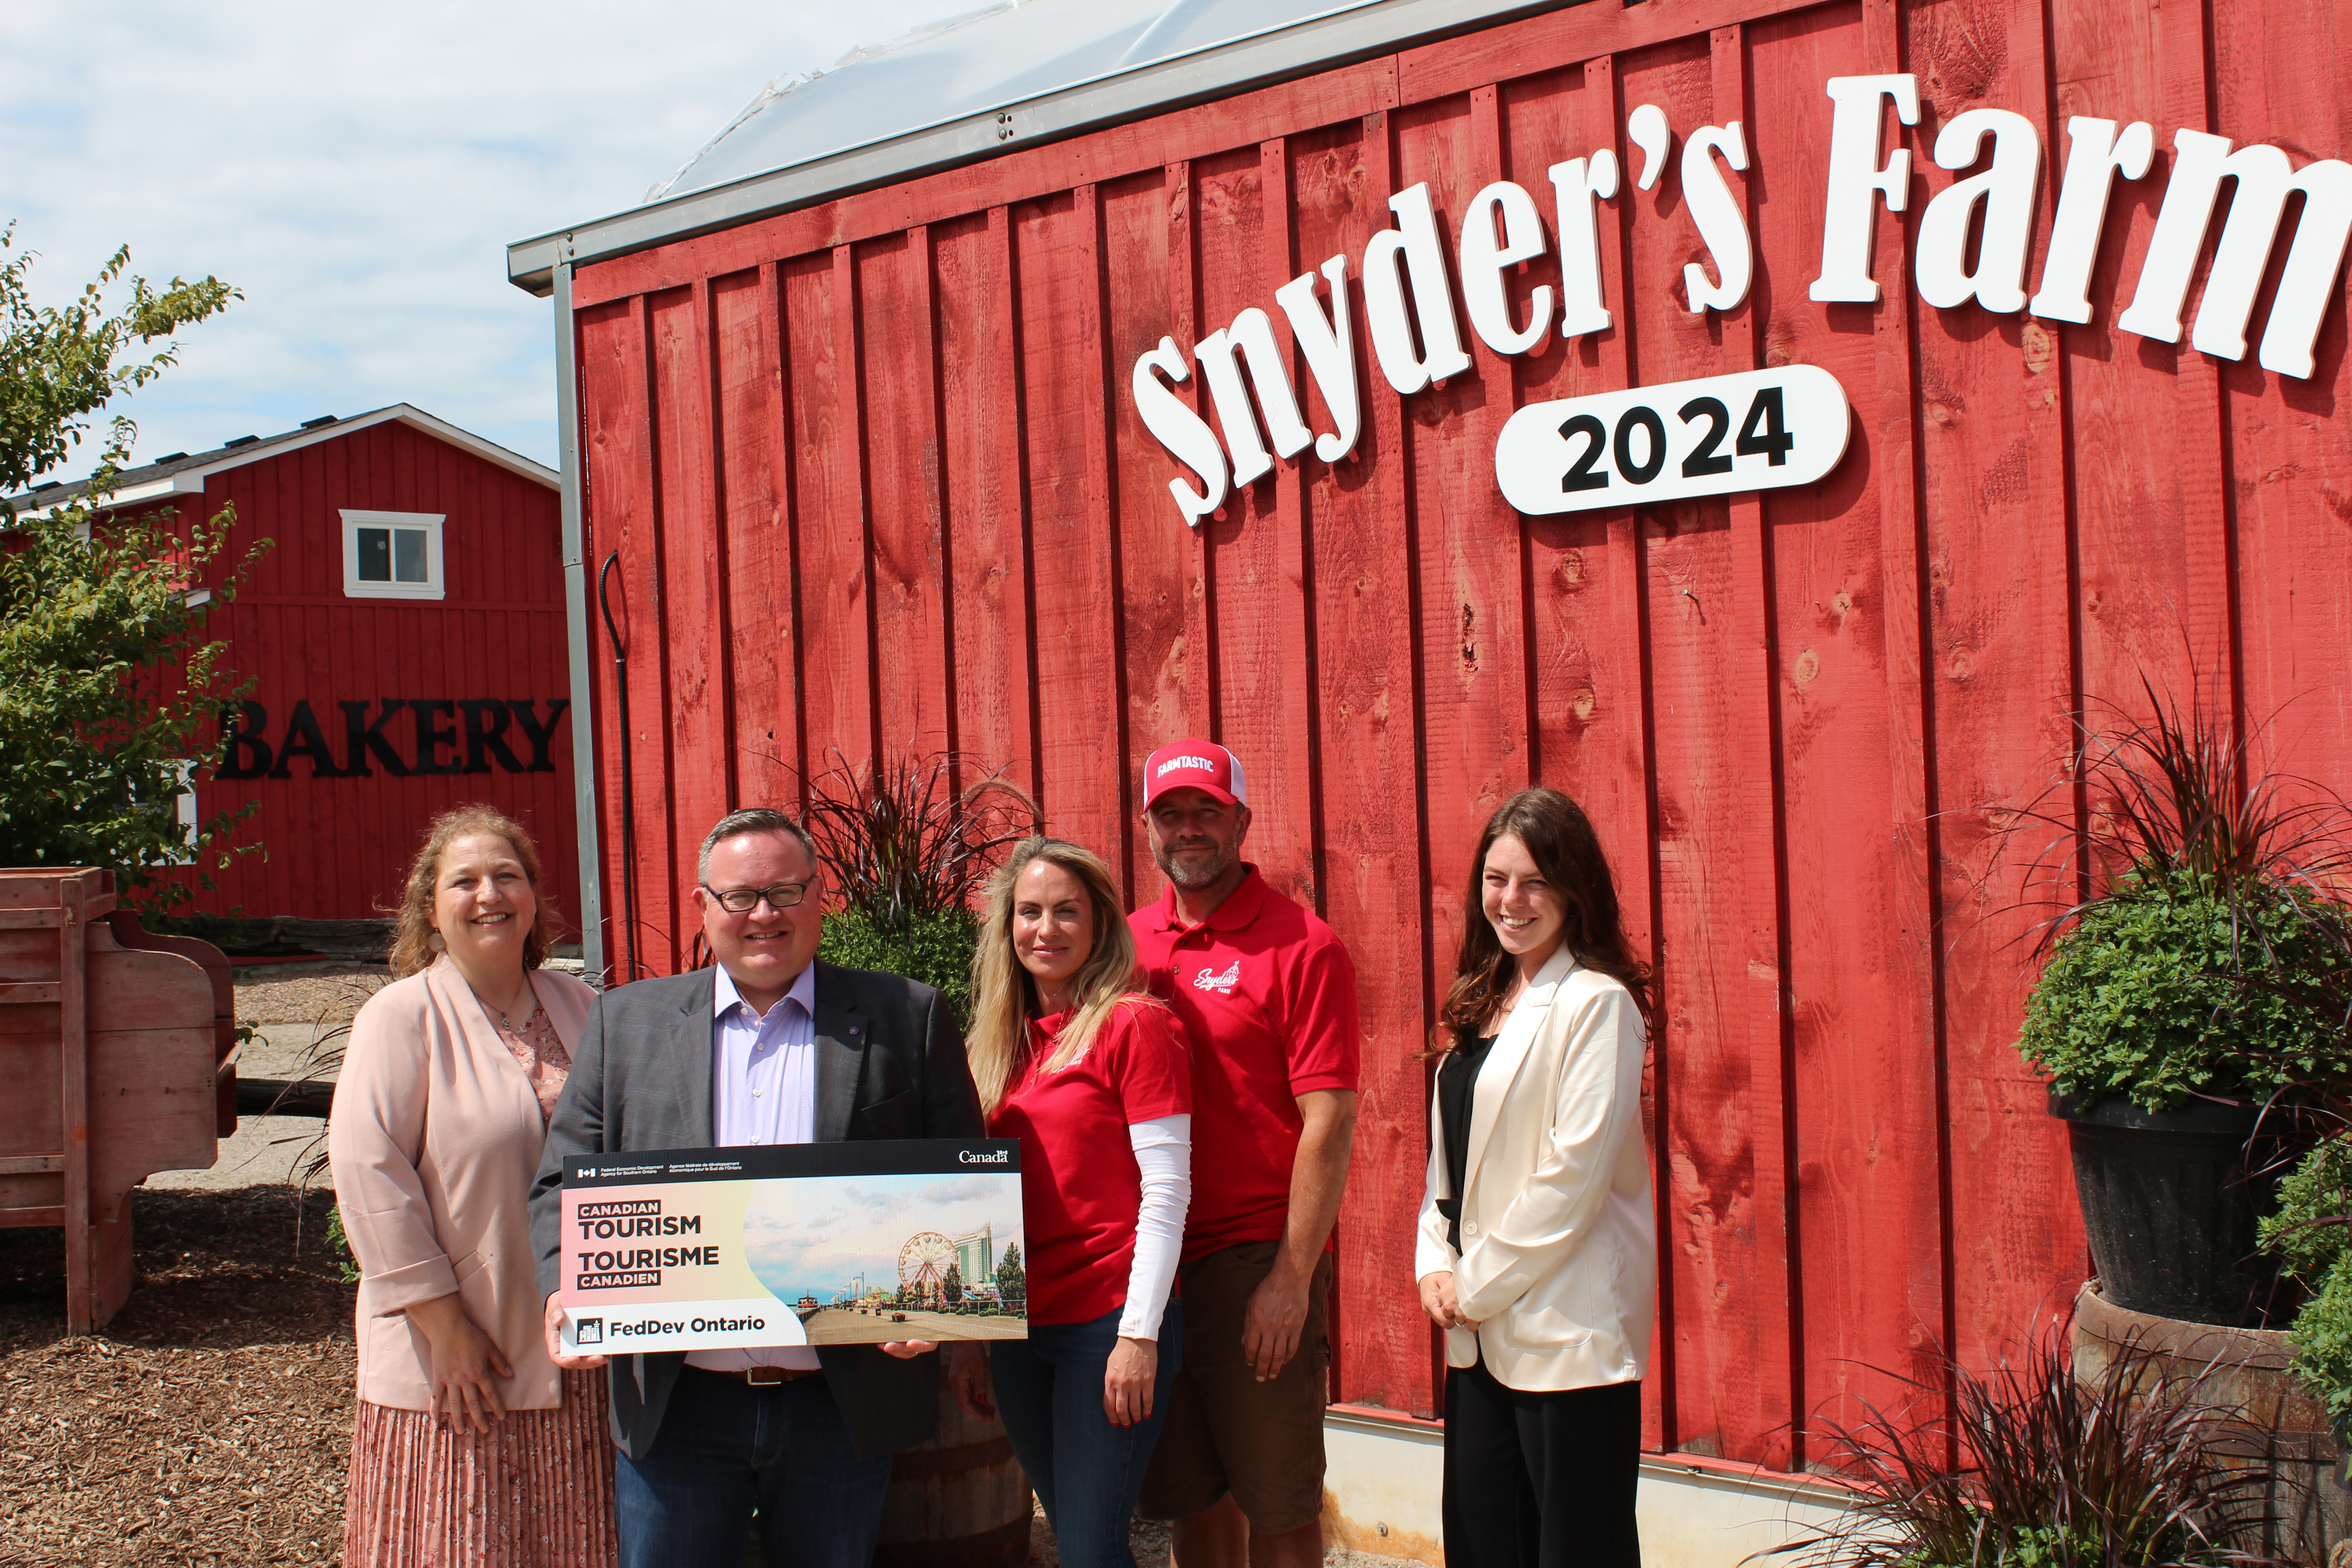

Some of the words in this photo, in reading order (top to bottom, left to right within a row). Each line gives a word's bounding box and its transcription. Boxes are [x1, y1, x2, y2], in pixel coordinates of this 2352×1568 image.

[1809, 73, 2352, 379] Farm
[1558, 387, 1793, 494] 2024
[215, 698, 569, 779] BAKERY
[1157, 756, 1214, 778] FARMTASTIC
[959, 1150, 1009, 1163] Canada
[580, 1202, 658, 1216] CANADIAN
[578, 1215, 701, 1240] TOURISM
[578, 1246, 719, 1271] TOURISME
[580, 1273, 658, 1288] CANADIEN
[610, 1320, 685, 1337] FedDev
[691, 1316, 765, 1332] Ontario
